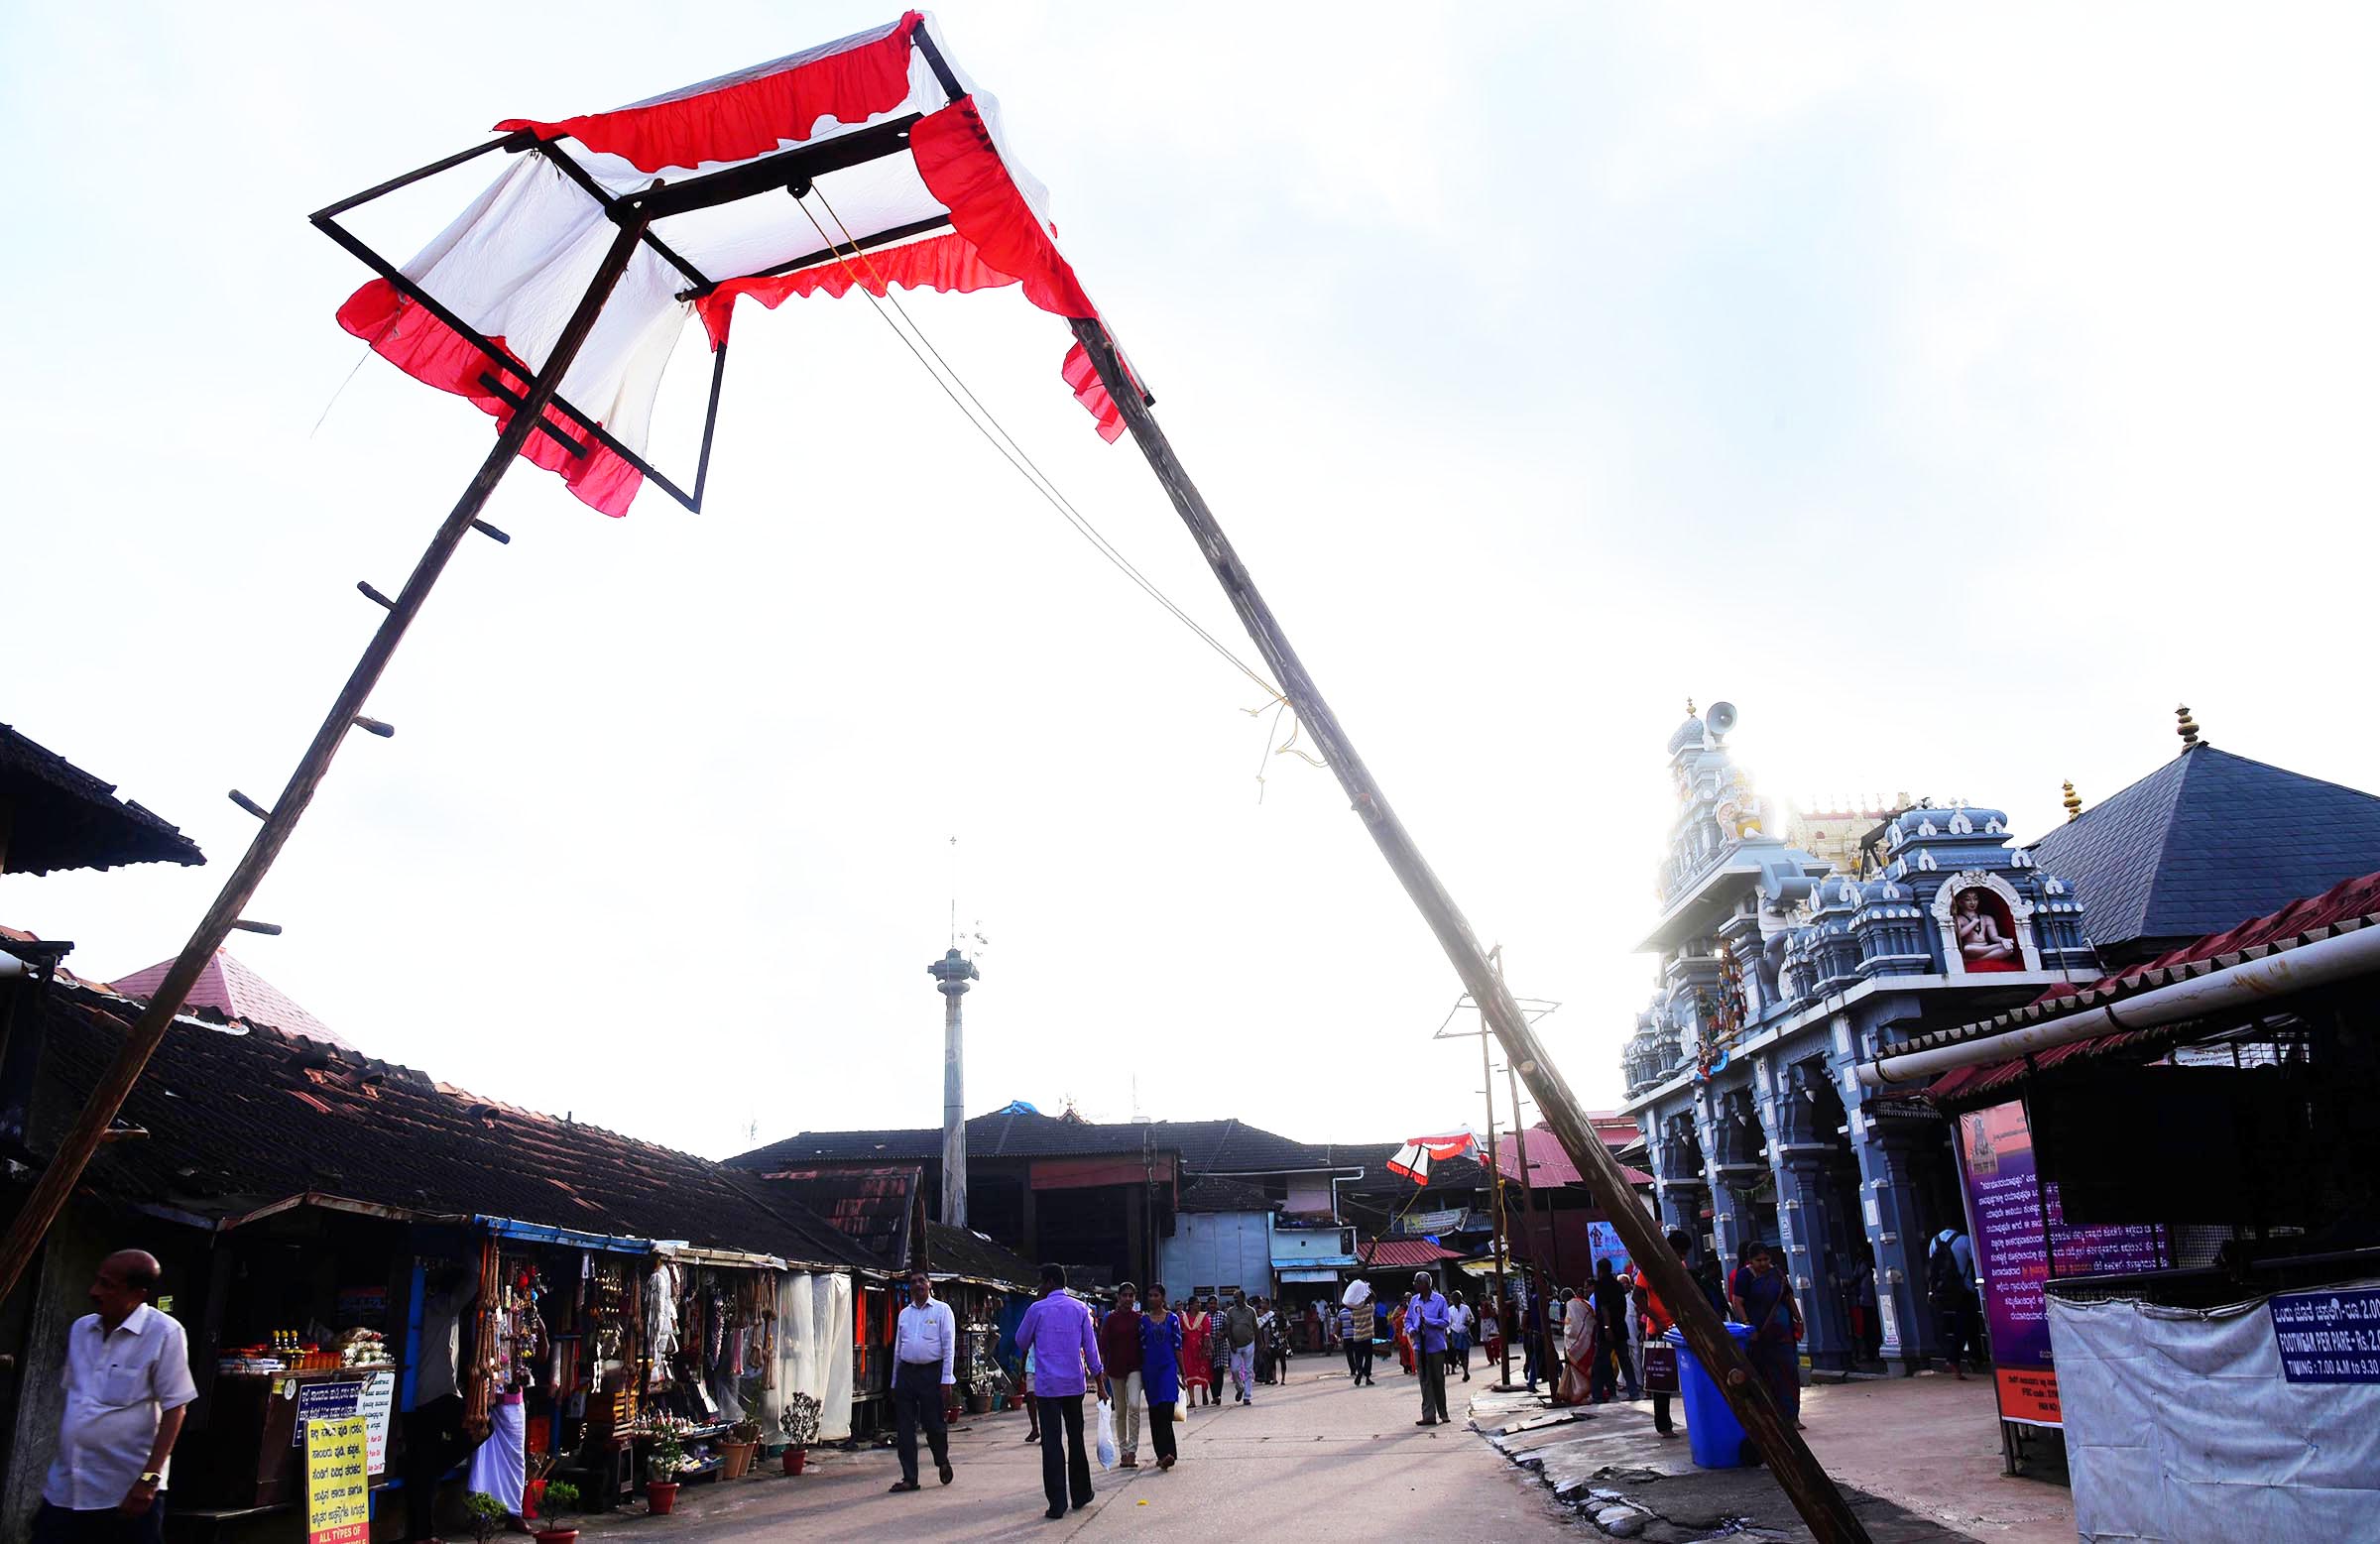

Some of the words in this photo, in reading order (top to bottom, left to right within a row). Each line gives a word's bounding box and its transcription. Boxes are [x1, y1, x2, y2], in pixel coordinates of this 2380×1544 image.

[2279, 1333, 2317, 1353] FOOTWEAR
[2316, 1332, 2332, 1351] PER
[2287, 1361, 2313, 1376] TIMING
[2318, 1360, 2334, 1374] 7.00
[2336, 1360, 2350, 1374] A.M
[2351, 1361, 2360, 1374] to
[2361, 1360, 2379, 1374] 9.30
[319, 1532, 331, 1543] ALL
[332, 1527, 352, 1540] TYPES
[353, 1525, 361, 1536] OF
